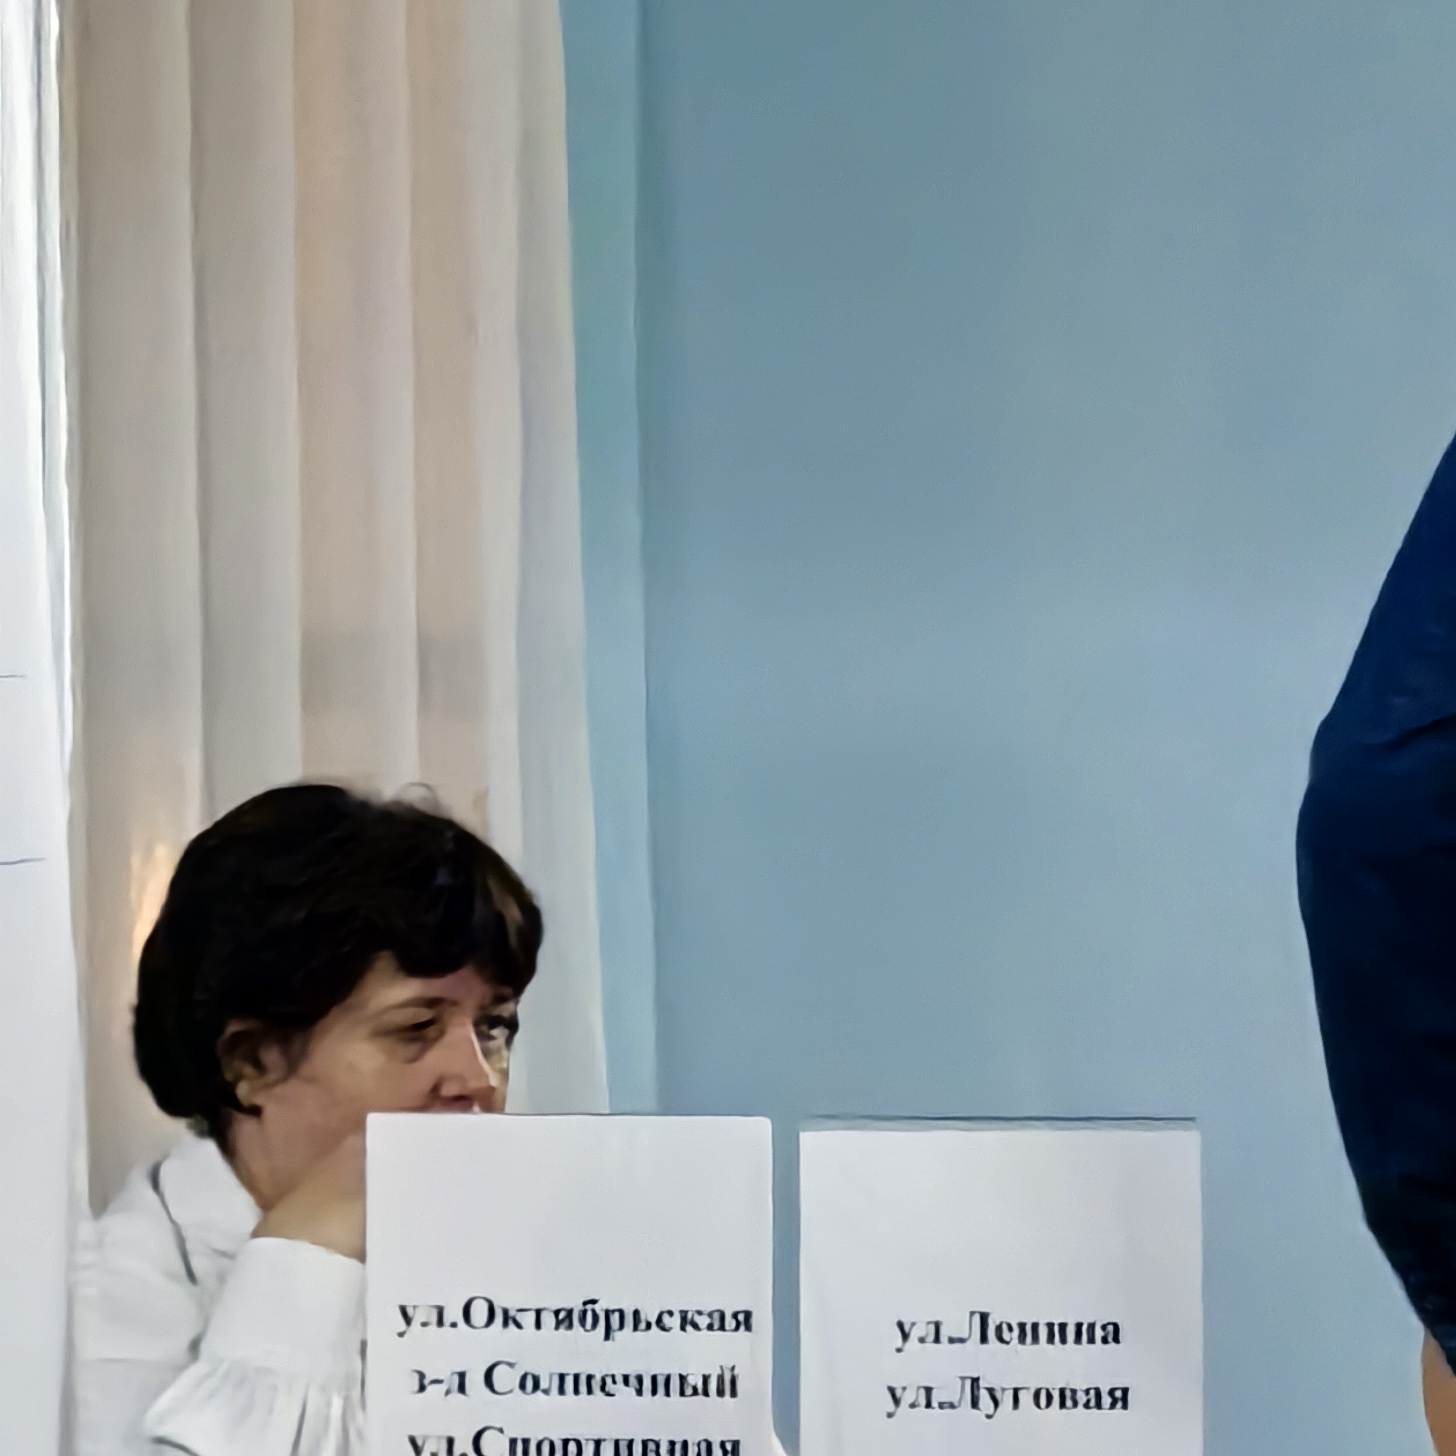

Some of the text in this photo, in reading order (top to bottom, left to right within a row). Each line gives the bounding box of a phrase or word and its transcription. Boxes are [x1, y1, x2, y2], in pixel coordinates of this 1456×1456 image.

[396, 1296, 754, 1342] ул.Октябрьская
[895, 1310, 1122, 1354] ул.Ленина
[483, 1359, 740, 1399] Солнечный
[886, 1375, 1131, 1420] ул.Луговая
